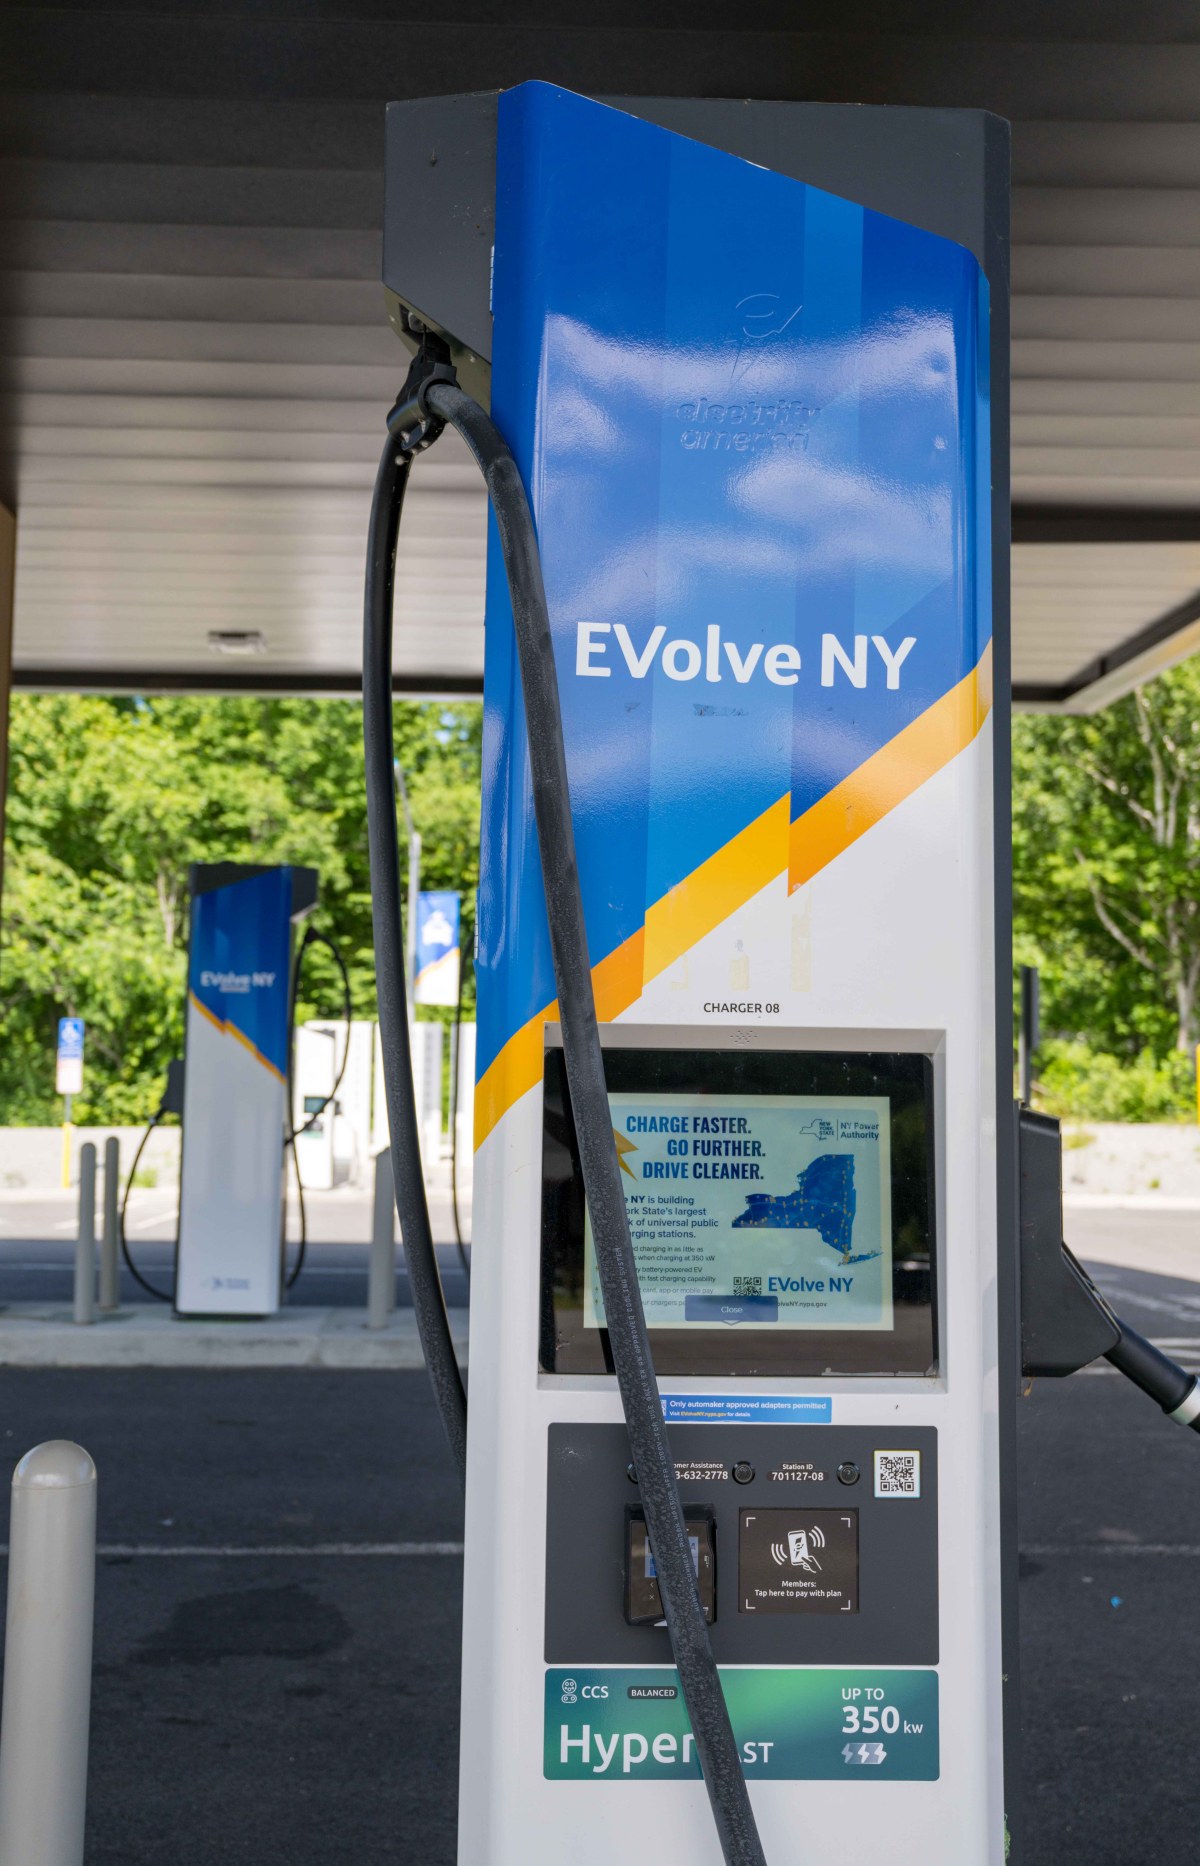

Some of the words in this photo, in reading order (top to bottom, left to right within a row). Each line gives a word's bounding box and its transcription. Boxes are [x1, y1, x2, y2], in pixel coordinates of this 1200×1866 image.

[575, 621, 802, 686] EVolve
[821, 633, 917, 690] NY
[703, 1003, 762, 1013] CHARGER
[765, 1004, 780, 1013] 08
[626, 1116, 689, 1133] CHARGE
[693, 1117, 752, 1134] FASTER.
[854, 1122, 879, 1130] Power
[840, 1131, 879, 1140] Authority
[667, 1139, 689, 1156] GO
[693, 1140, 766, 1157] FURTHER.
[642, 1162, 689, 1179] DRIVE
[693, 1163, 764, 1179] CLEANER.
[631, 1195, 645, 1204] NY
[648, 1196, 655, 1204] is
[658, 1196, 694, 1206] building
[626, 1207, 639, 1215] ork
[642, 1207, 673, 1215] State's
[675, 1208, 706, 1216] largest
[636, 1219, 645, 1227] of
[648, 1219, 688, 1227] universal
[692, 1219, 719, 1228] public
[658, 1231, 696, 1239] stations.
[768, 1277, 824, 1292] EVolve
[829, 1278, 853, 1293] NY
[777, 1301, 828, 1309] olveNY.nypa.gov
[721, 1306, 743, 1314] Close
[726, 1401, 759, 1409] approved
[761, 1402, 791, 1410] adapters
[793, 1402, 826, 1410] permitted
[675, 1471, 729, 1480] 3-632-2778
[772, 1472, 824, 1481] 701127-08
[781, 1580, 817, 1588] Members:
[755, 1589, 768, 1598] Tap
[769, 1589, 785, 1597] here
[809, 1589, 825, 1597] with
[826, 1590, 842, 1598] plan
[582, 1686, 609, 1698] CCS
[631, 1689, 675, 1697] BALANCED
[841, 1688, 861, 1700] UP
[864, 1688, 885, 1700] TO
[842, 1705, 900, 1734] 350
